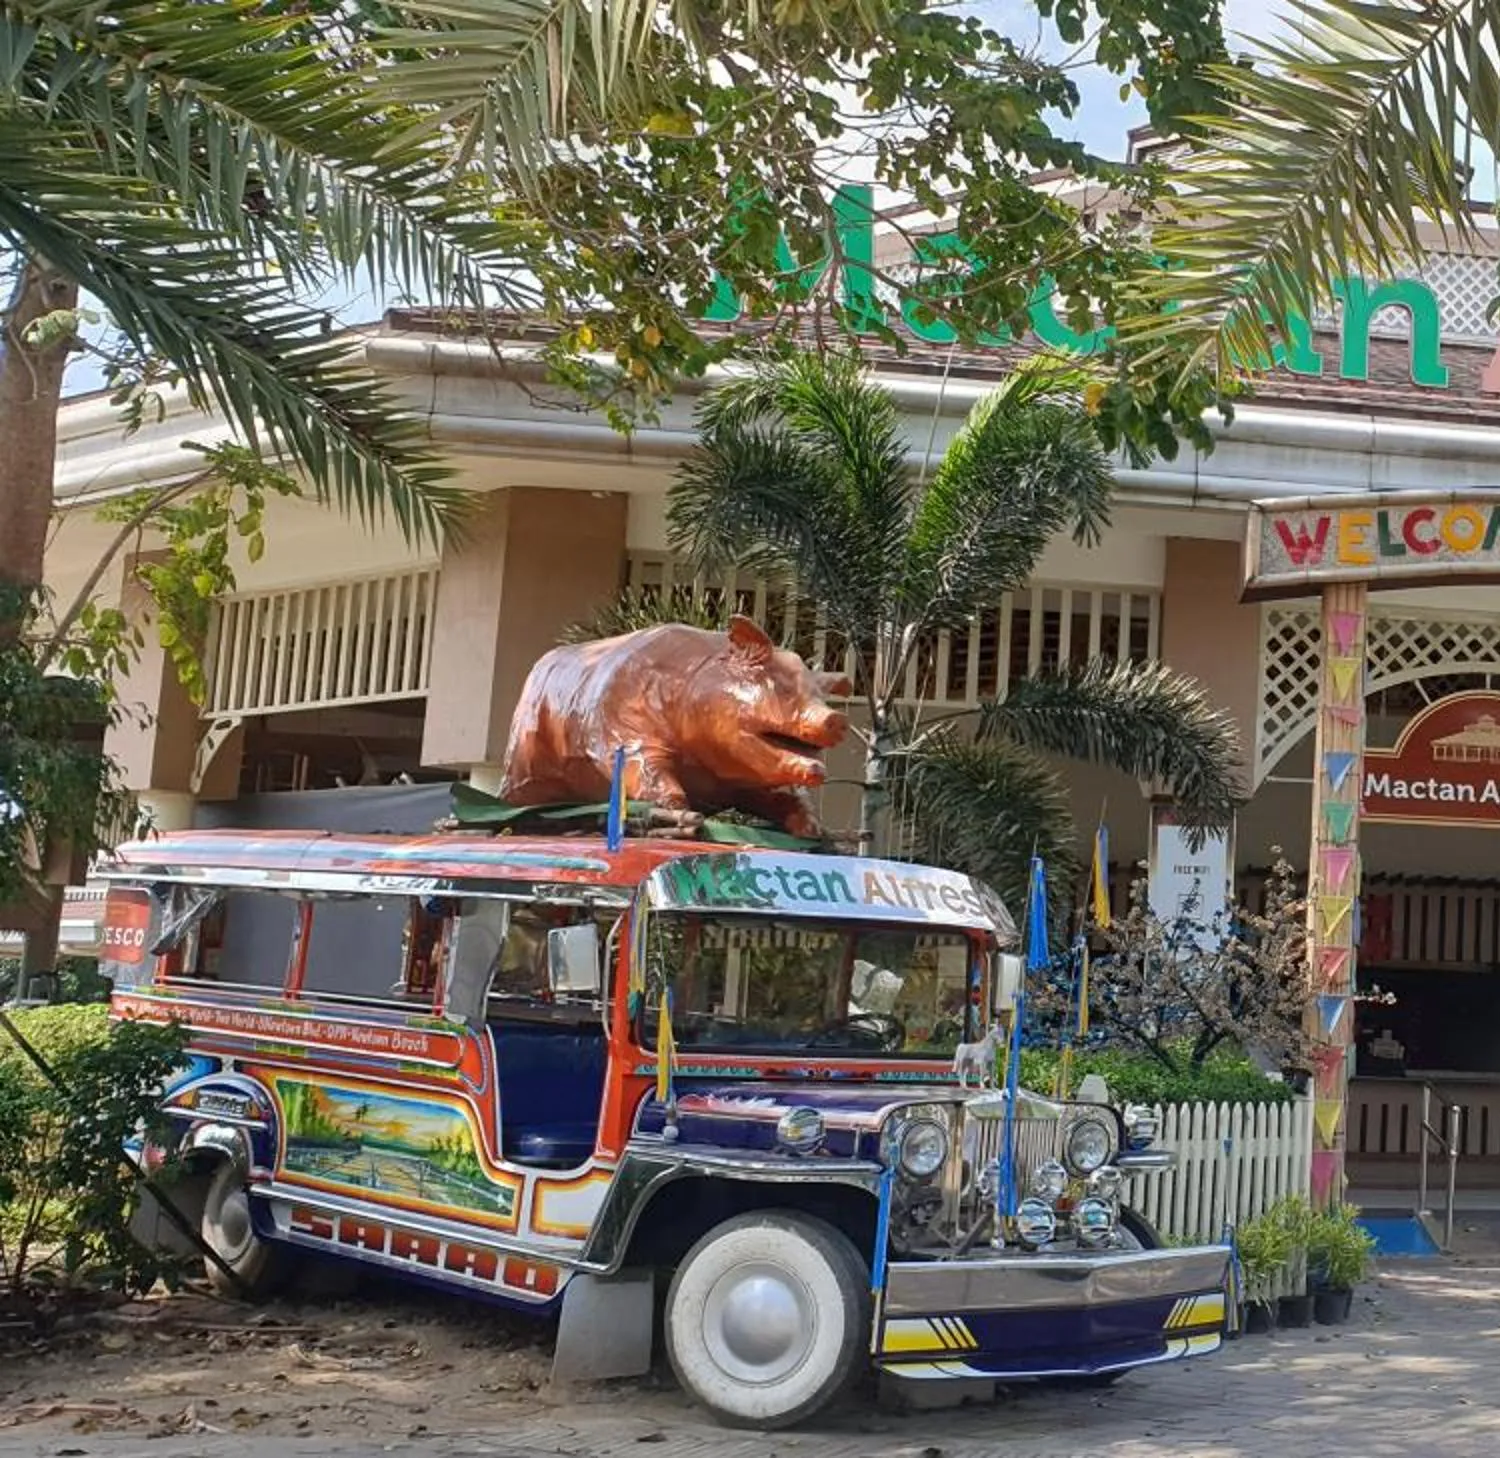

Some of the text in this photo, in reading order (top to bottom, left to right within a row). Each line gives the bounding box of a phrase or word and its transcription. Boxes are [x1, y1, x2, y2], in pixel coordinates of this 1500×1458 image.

[702, 168, 1449, 388] Macan
[1363, 773, 1476, 803] Mactan
[672, 860, 857, 905] Mactan
